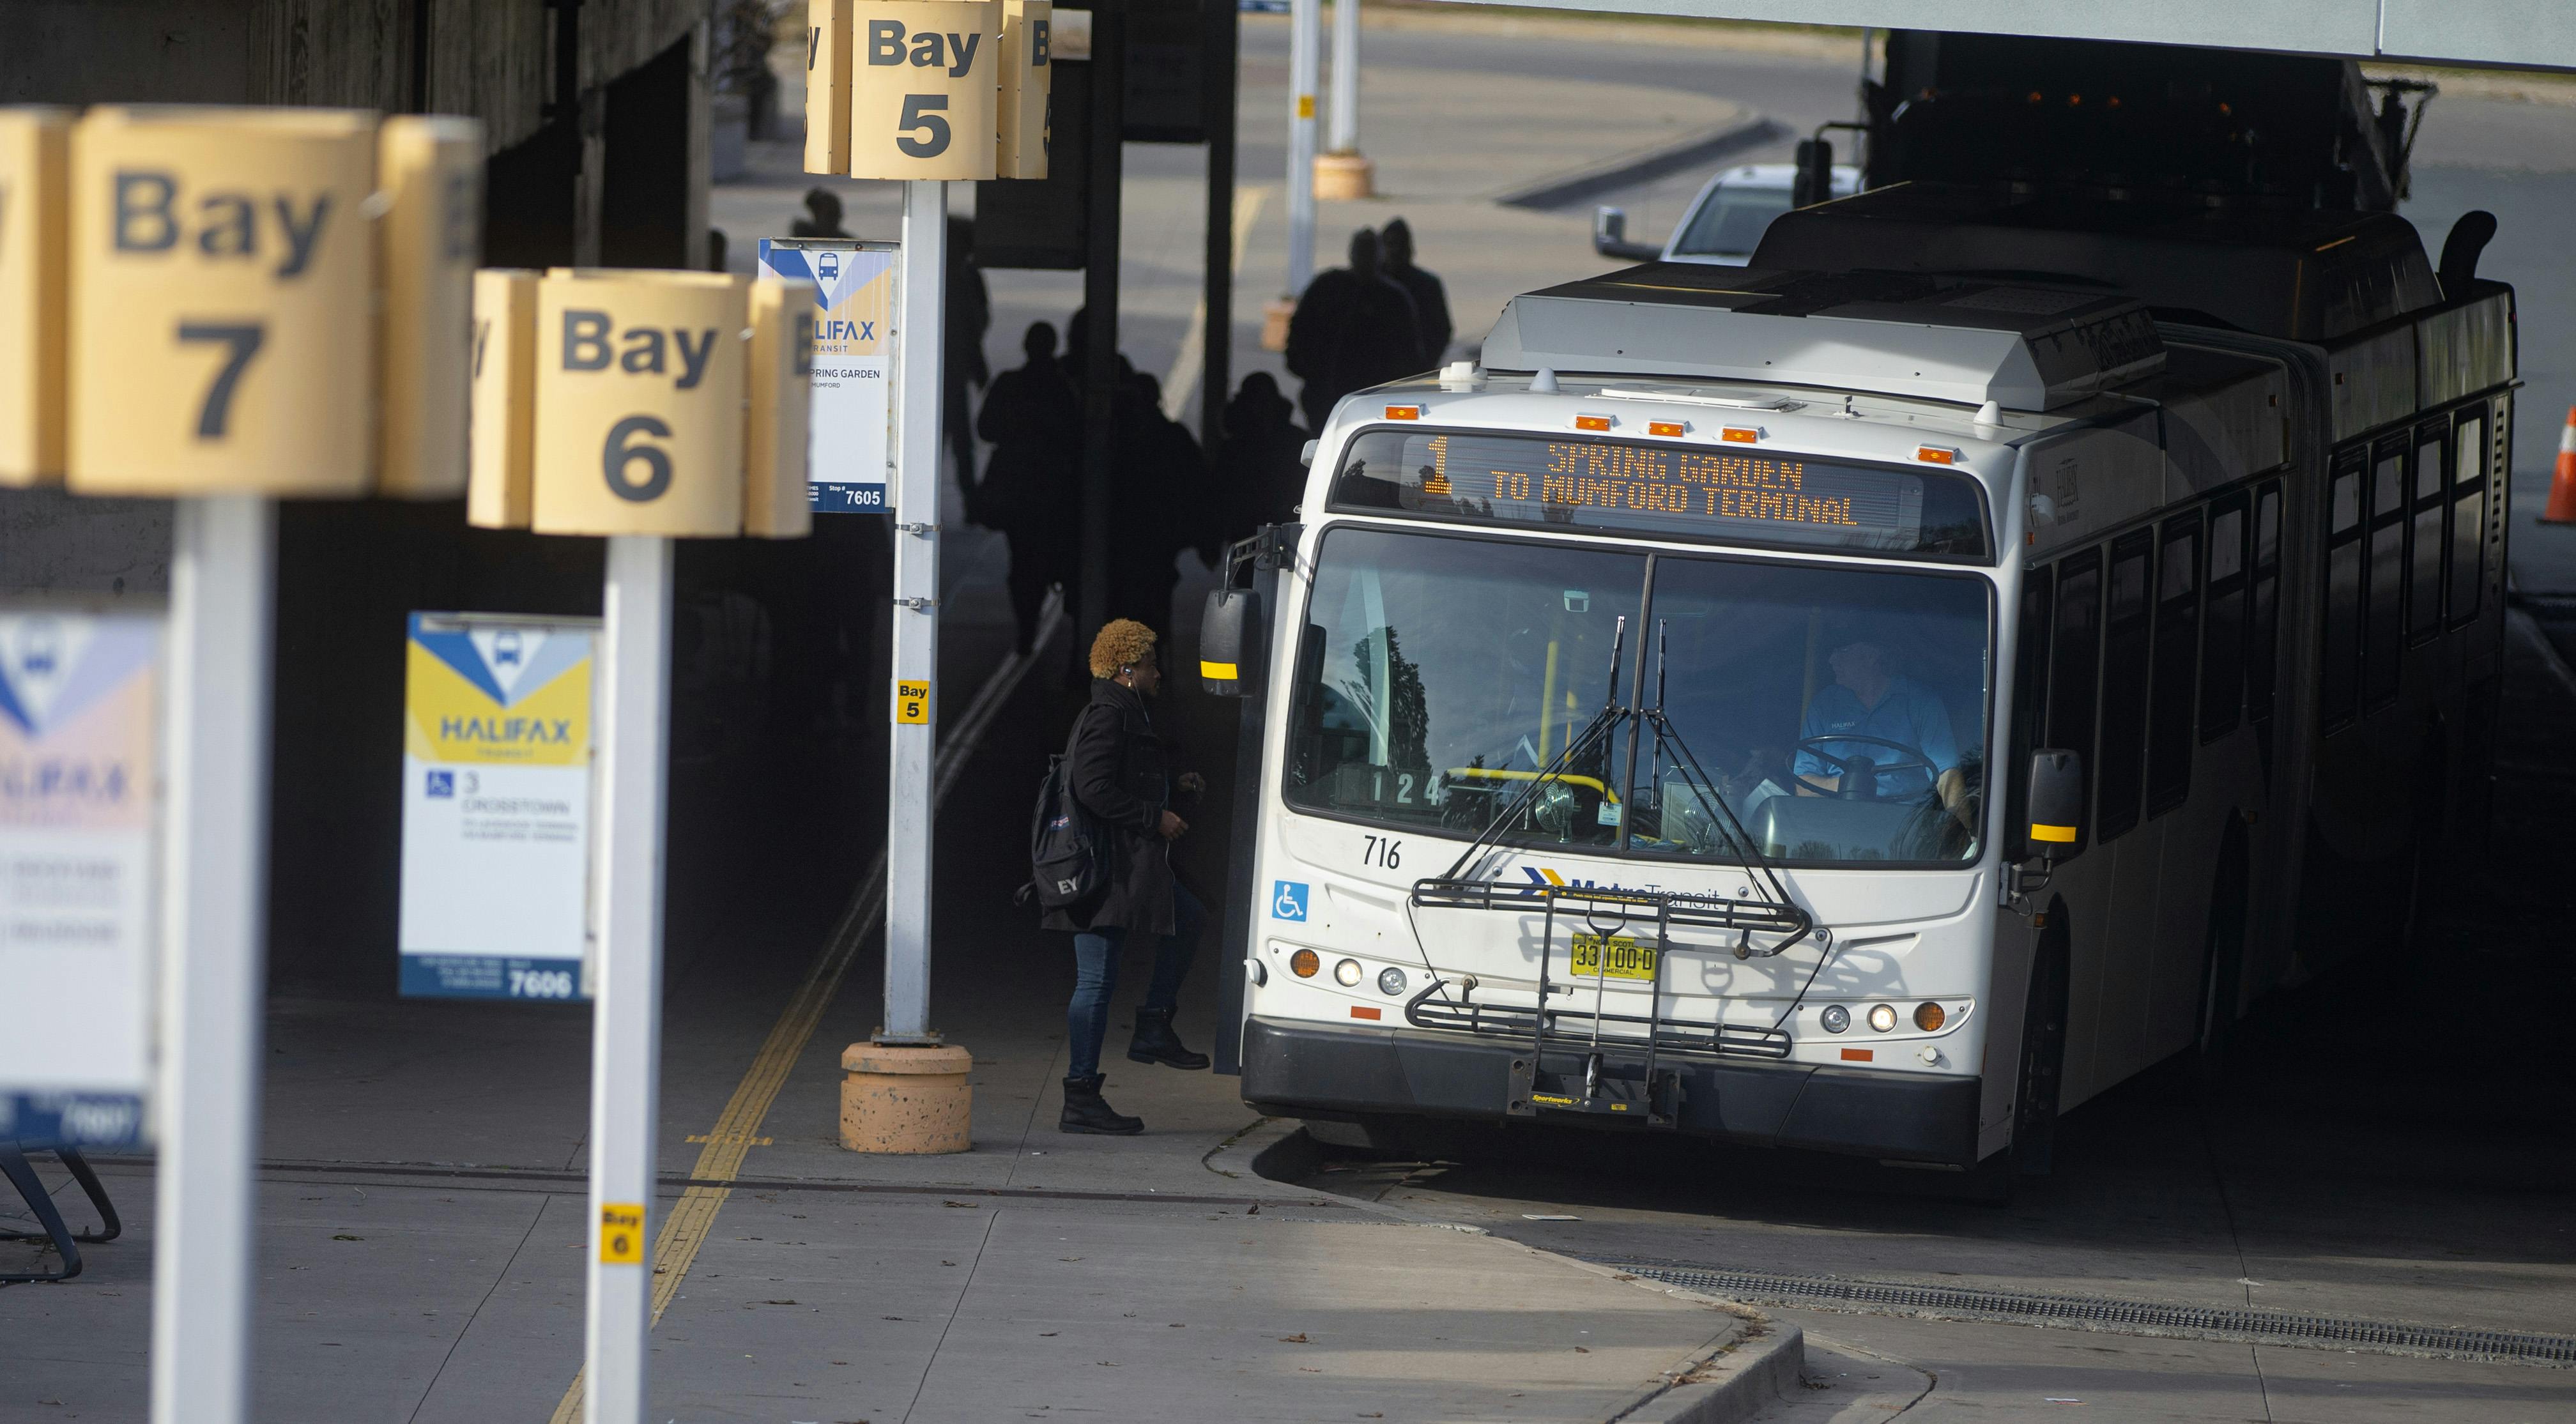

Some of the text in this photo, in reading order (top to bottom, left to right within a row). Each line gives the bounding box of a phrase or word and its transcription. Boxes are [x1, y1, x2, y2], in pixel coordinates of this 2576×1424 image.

[869, 20, 982, 78] Bay
[896, 94, 951, 158] 5
[114, 170, 330, 279] Bay
[813, 321, 874, 340] LIFAX
[562, 309, 720, 390] Bay
[176, 321, 267, 438] 7
[809, 369, 880, 378] PRING GARDEN
[602, 413, 674, 503] 6
[1425, 436, 1452, 494] 1
[1547, 443, 1667, 479] SPRING
[846, 491, 880, 505] 7605
[1491, 471, 1858, 525] TO MUMFORD TERMINAL
[900, 685, 927, 699] Bay
[907, 702, 919, 717] 5
[441, 716, 571, 744] HALIFAX
[1364, 834, 1402, 869] 716
[1057, 875, 1078, 894] EY
[509, 969, 572, 998] 7606
[1533, 1094, 1572, 1105] Sportworks
[602, 1211, 638, 1229] Bay
[613, 1236, 629, 1255] 6
